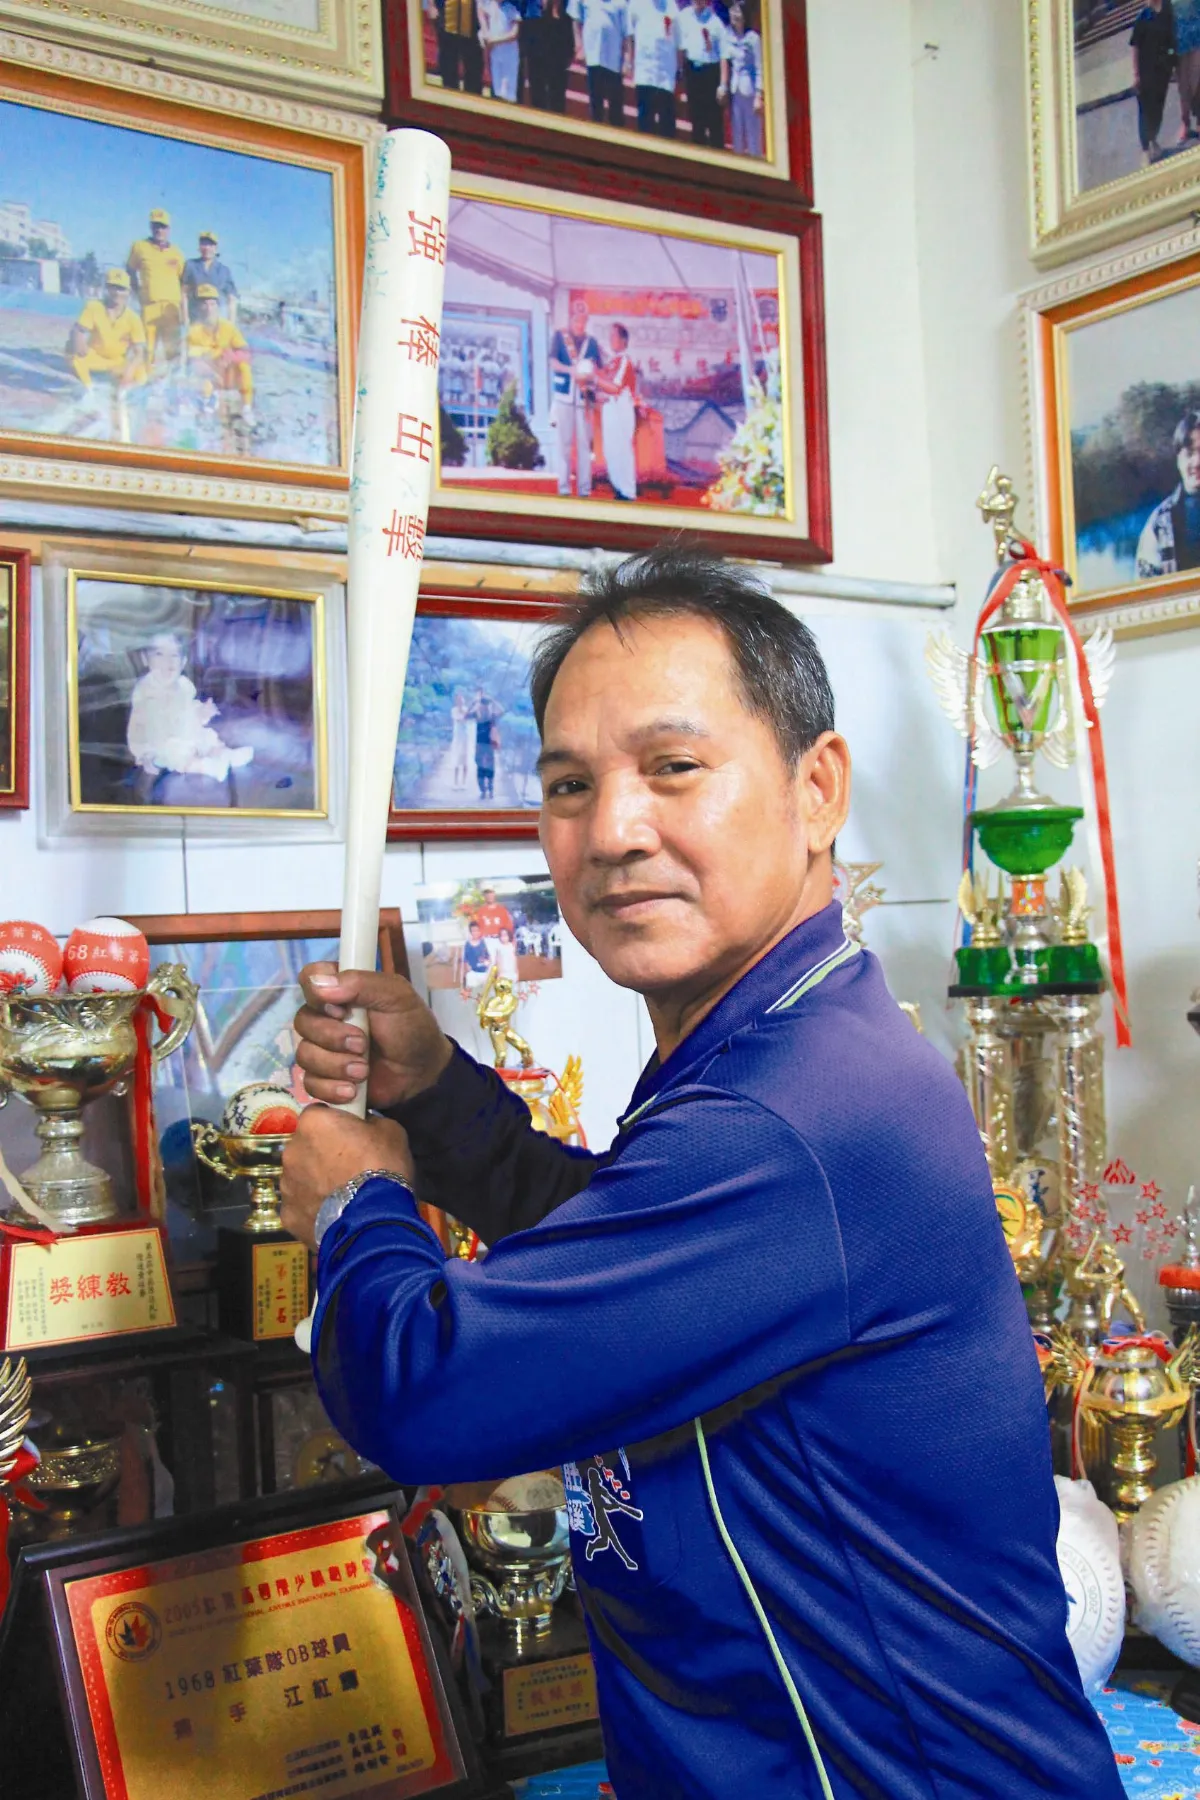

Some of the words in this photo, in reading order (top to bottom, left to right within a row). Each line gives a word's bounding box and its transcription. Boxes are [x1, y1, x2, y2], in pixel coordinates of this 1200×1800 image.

[382, 210, 447, 560] 強棒出擊
[164, 1670, 215, 1700] 1968
